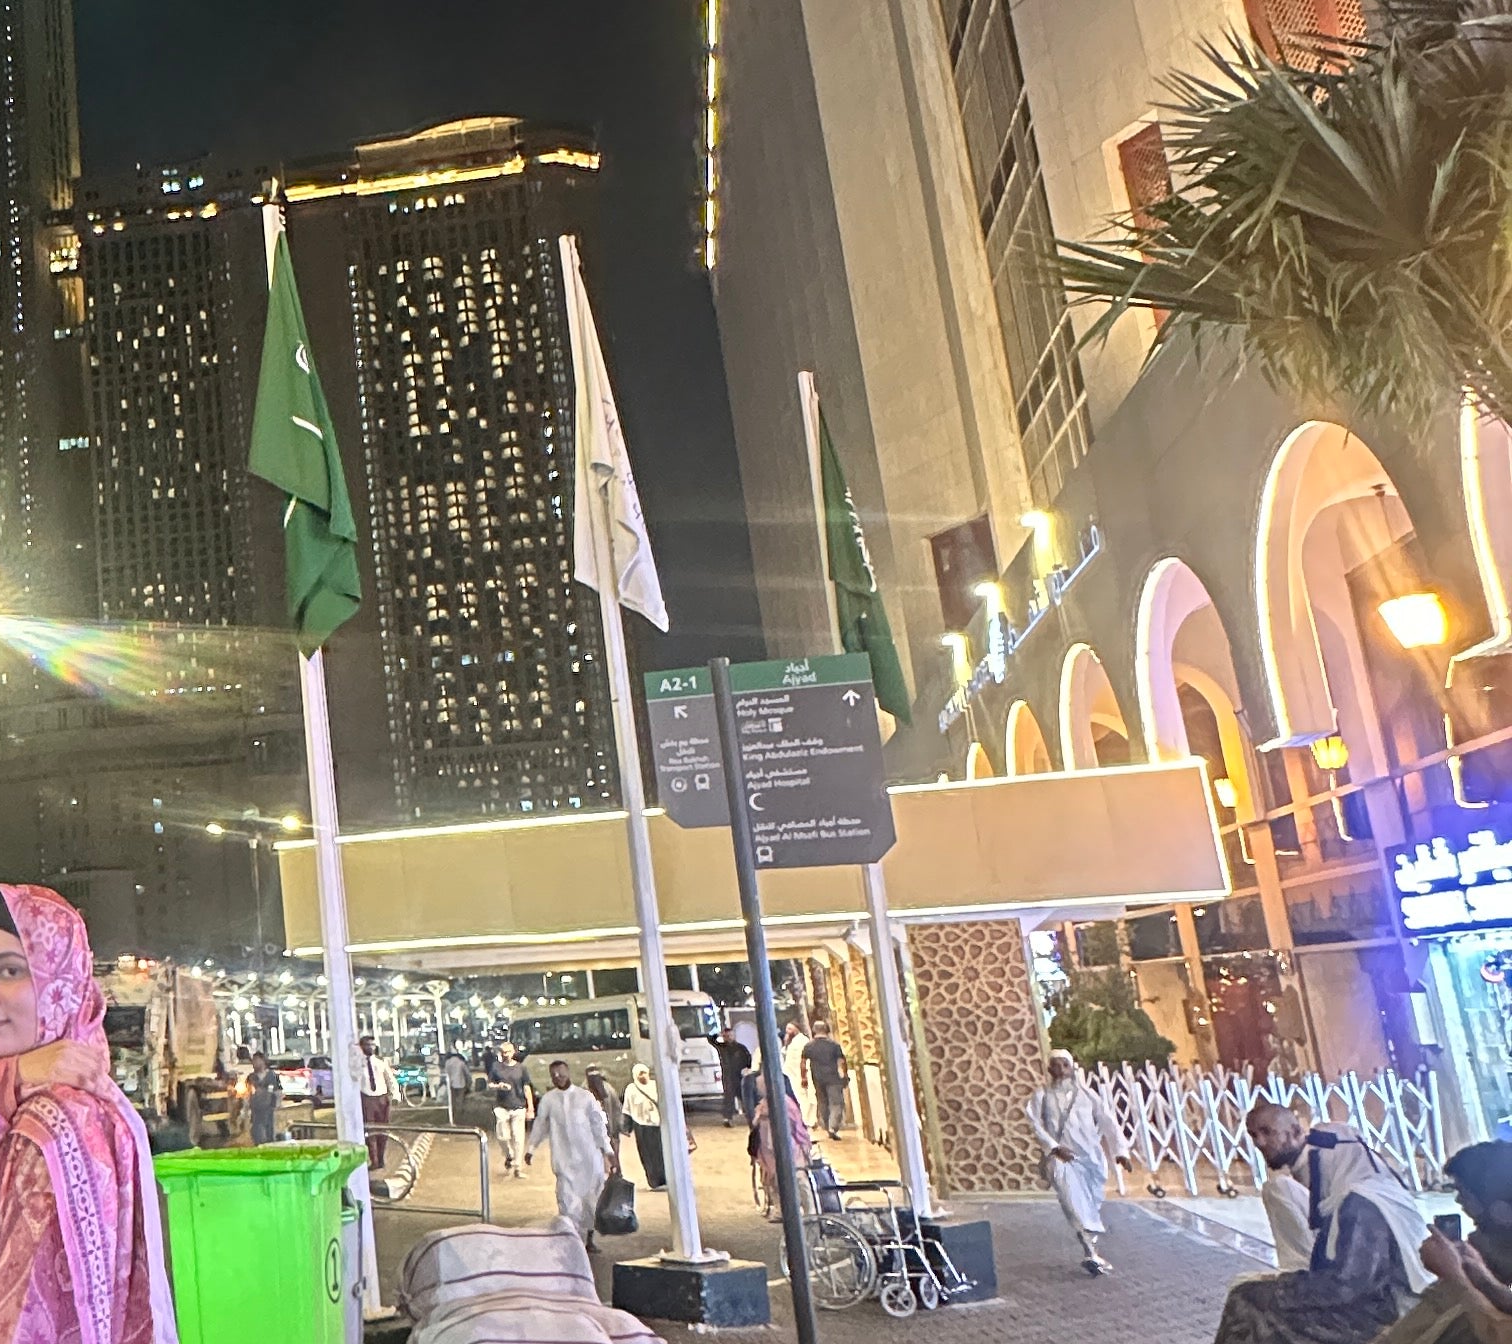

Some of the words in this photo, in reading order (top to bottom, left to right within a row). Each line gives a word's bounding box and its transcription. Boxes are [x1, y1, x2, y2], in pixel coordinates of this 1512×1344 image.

[785, 658, 810, 674] أجياد
[660, 676, 697, 693] A2-1
[782, 672, 817, 686] Ajyad
[742, 751, 763, 762] King
[765, 748, 809, 759] Abdulaziz
[810, 744, 864, 756] Endowment
[747, 780, 772, 791] Ajyad
[774, 777, 811, 788] Hospital
[755, 832, 780, 843] Ajyad
[782, 832, 792, 841] Al
[820, 829, 837, 839] Bus
[838, 827, 871, 838] Station
